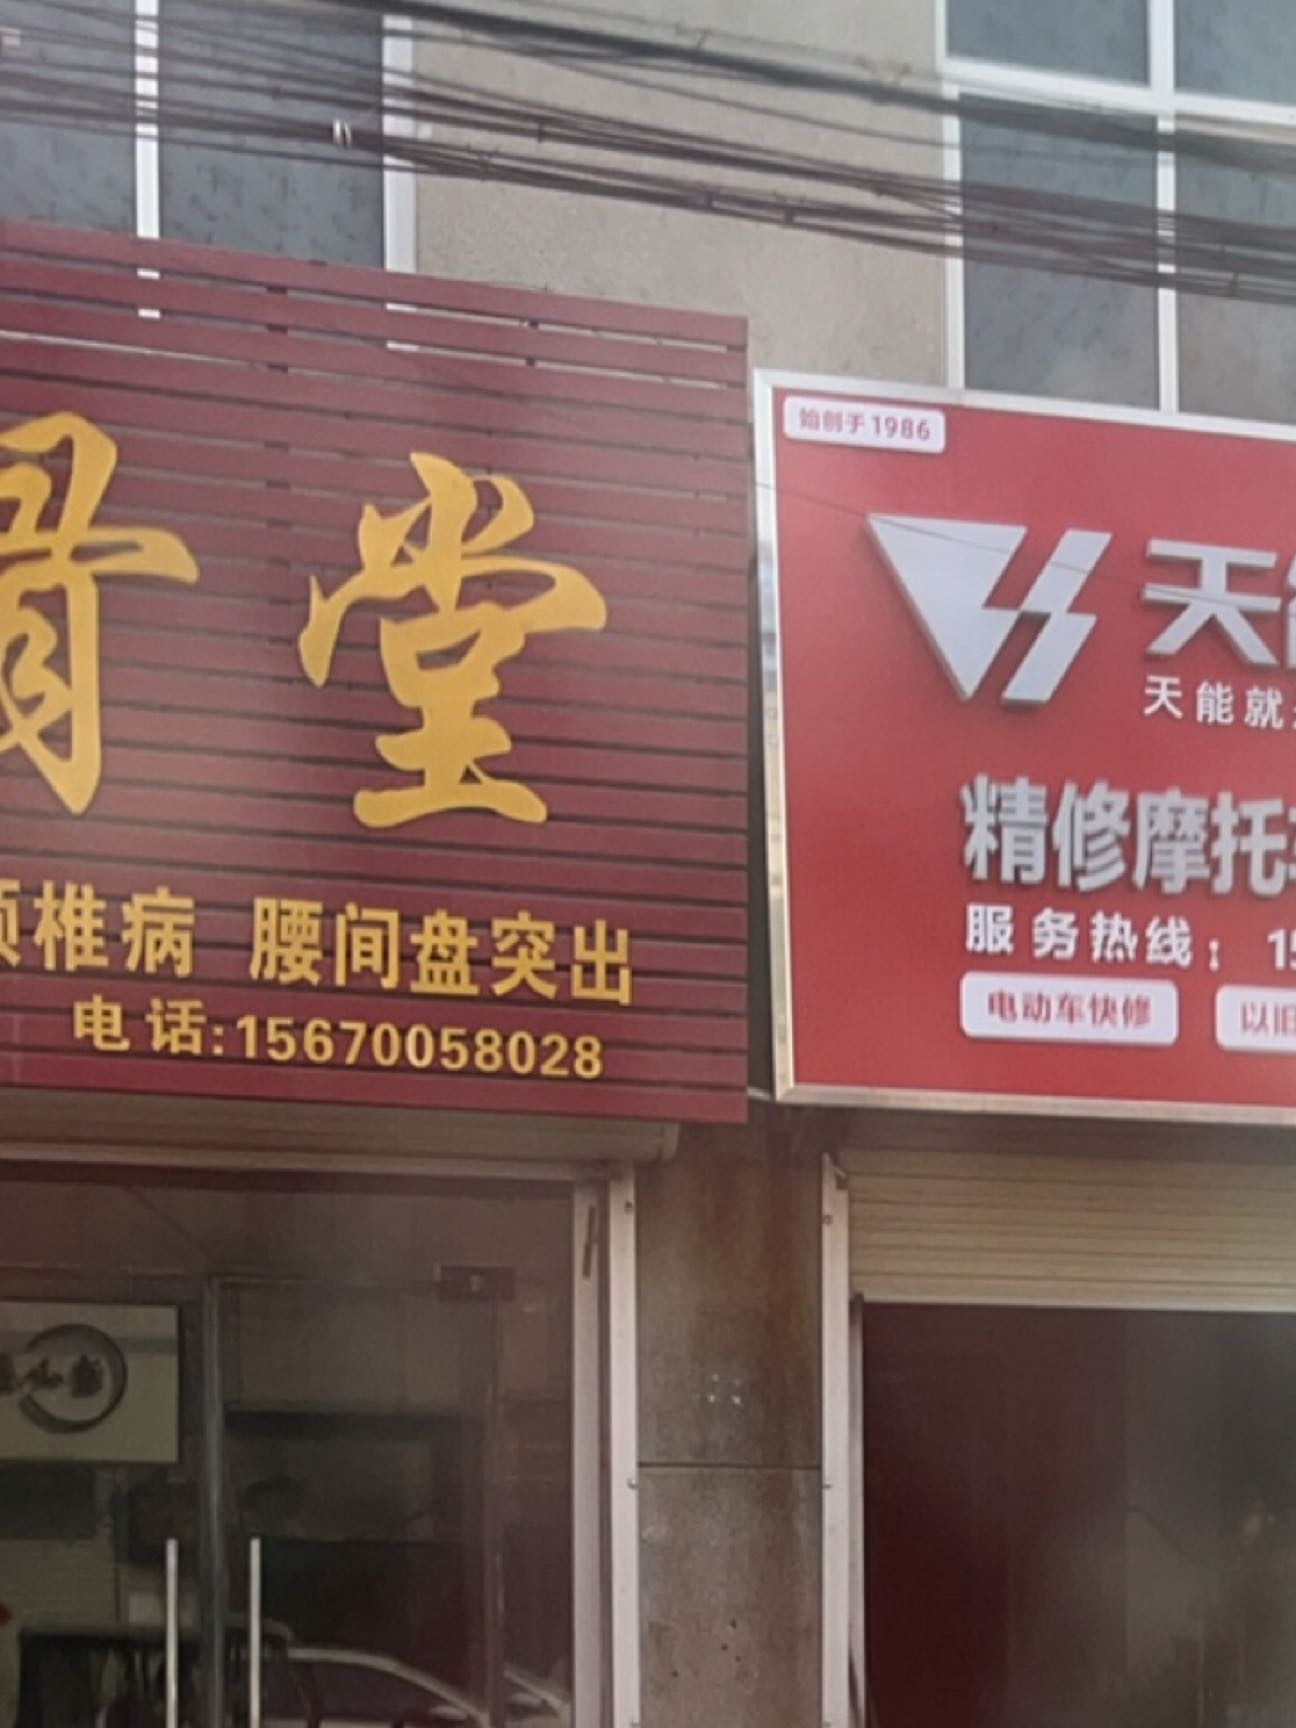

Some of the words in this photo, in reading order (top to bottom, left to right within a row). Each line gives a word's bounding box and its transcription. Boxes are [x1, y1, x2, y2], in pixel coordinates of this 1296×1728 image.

[250, 896, 634, 1005] 腰间盘突出
[987, 990, 1152, 1028] 电动车快修
